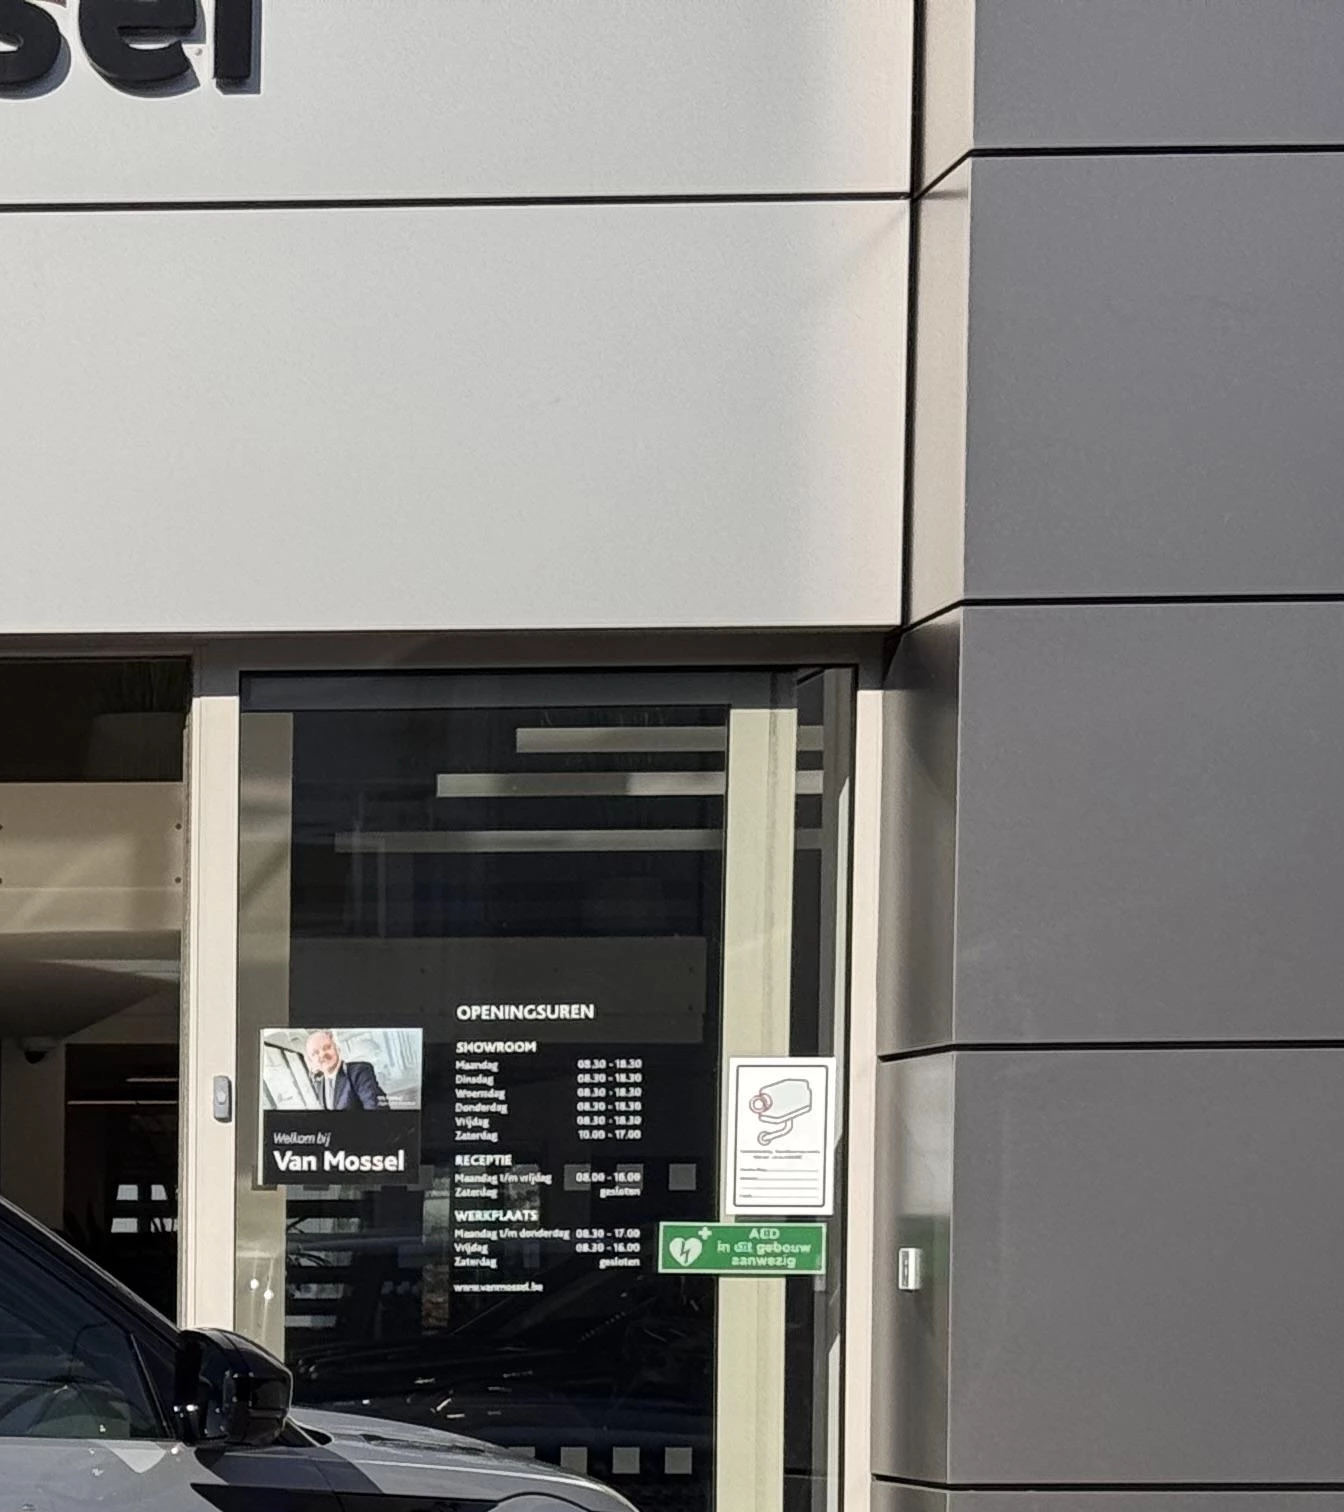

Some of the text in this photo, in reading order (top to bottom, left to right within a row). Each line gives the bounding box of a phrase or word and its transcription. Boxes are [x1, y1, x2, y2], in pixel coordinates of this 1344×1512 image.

[456, 1004, 595, 1020] OPENINGSUREN
[455, 1041, 537, 1053] SHOWROOM
[455, 1060, 499, 1072] Maandag
[455, 1074, 494, 1086] Dinsdag
[455, 1088, 505, 1100] Woensdag
[455, 1102, 508, 1114] Donderdag
[455, 1116, 490, 1128] Vrijdag
[273, 1131, 332, 1147] Welkom bij
[455, 1130, 499, 1142] Zaterdag
[577, 1129, 606, 1140] 10.00
[614, 1129, 642, 1140] 17.00
[273, 1149, 405, 1171] Van Mossel
[454, 1155, 512, 1166] RECEPTIE
[454, 1173, 498, 1185] Maandag
[499, 1173, 518, 1183] t/m
[519, 1172, 552, 1186] vrijdag
[454, 1186, 641, 1199] Zaterdag gesloten
[454, 1210, 539, 1221] WERKPLAATS
[454, 1229, 498, 1240] Maandag
[499, 1228, 518, 1239] t/m
[519, 1228, 571, 1240] donderdag
[613, 1228, 640, 1239] 17.00
[749, 1228, 780, 1239] AED
[454, 1242, 489, 1255] Vrijdag
[718, 1240, 812, 1255] in dit gebouw
[454, 1256, 641, 1269] Zaterdag gesloten
[731, 1254, 797, 1268] aanwezig
